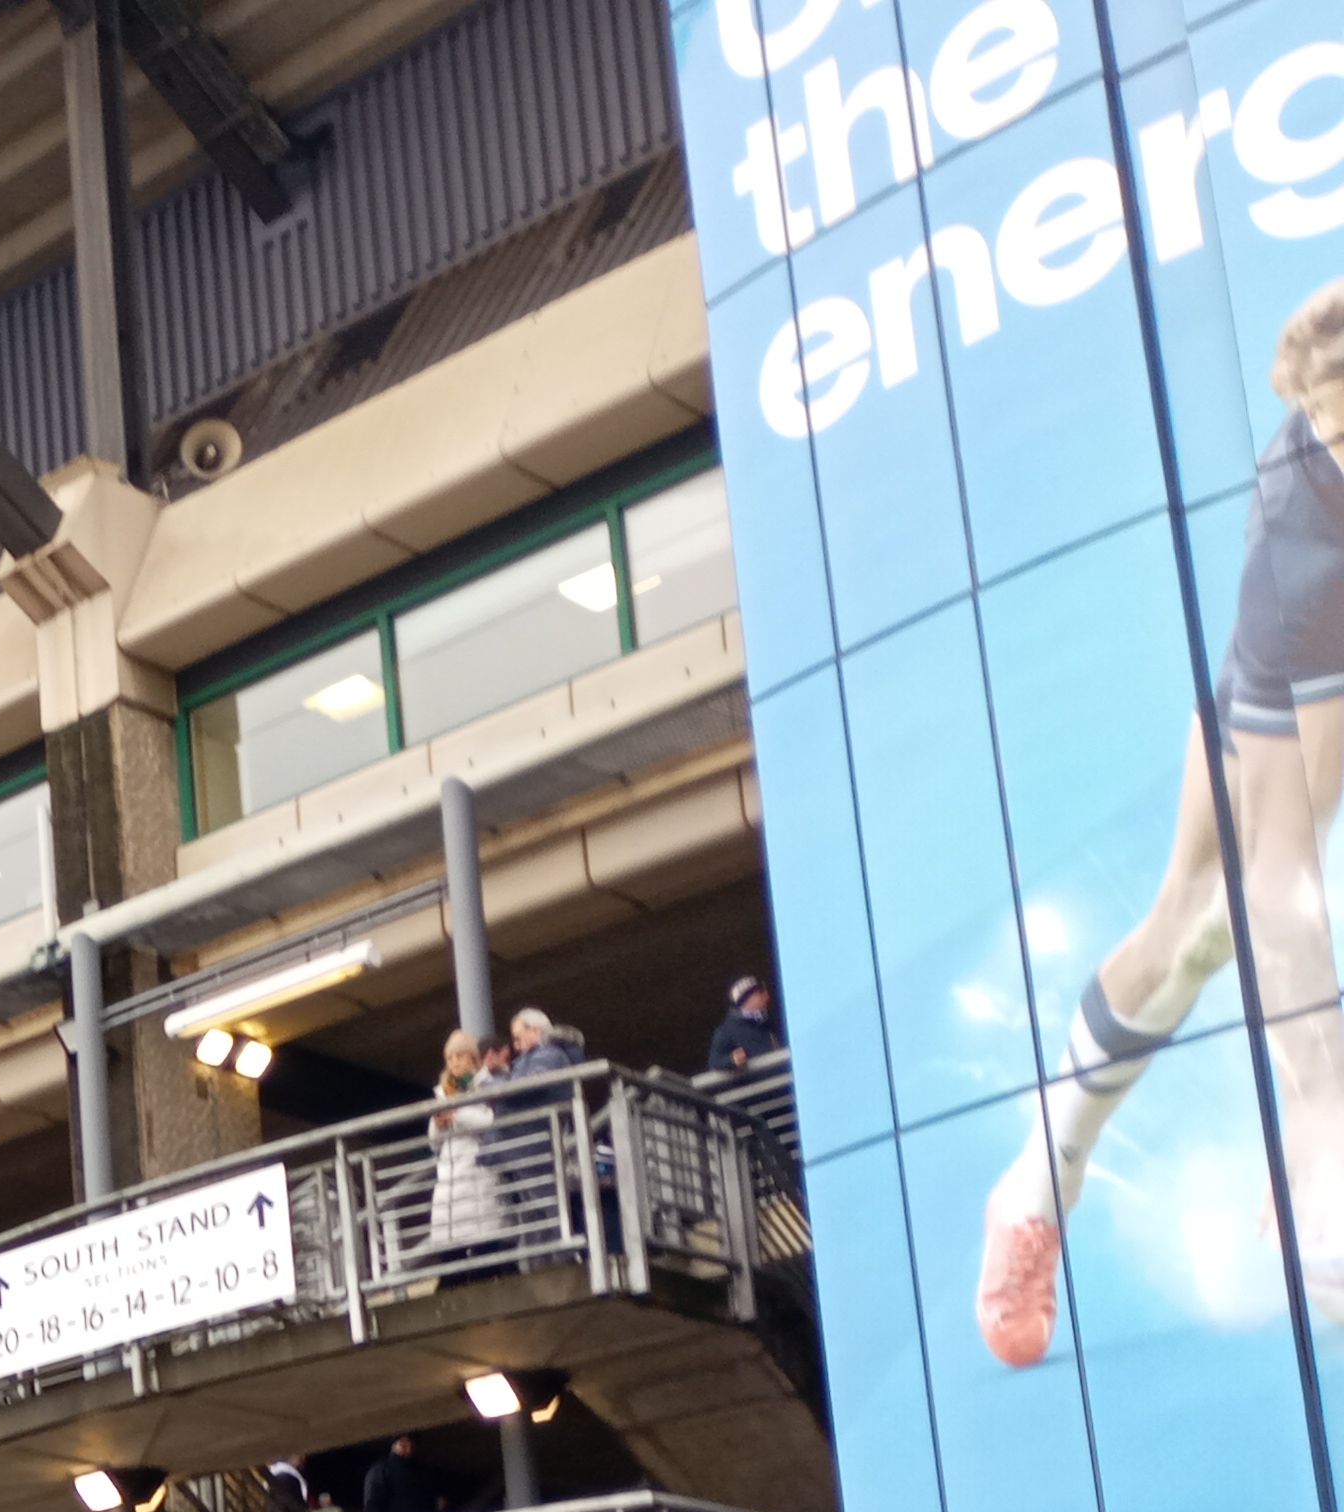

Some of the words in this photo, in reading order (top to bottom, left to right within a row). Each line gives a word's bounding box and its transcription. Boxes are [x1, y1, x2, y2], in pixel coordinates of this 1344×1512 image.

[733, 0, 1059, 255] the
[23, 1236, 121, 1287] SOUTH
[137, 1201, 232, 1252] STAND
